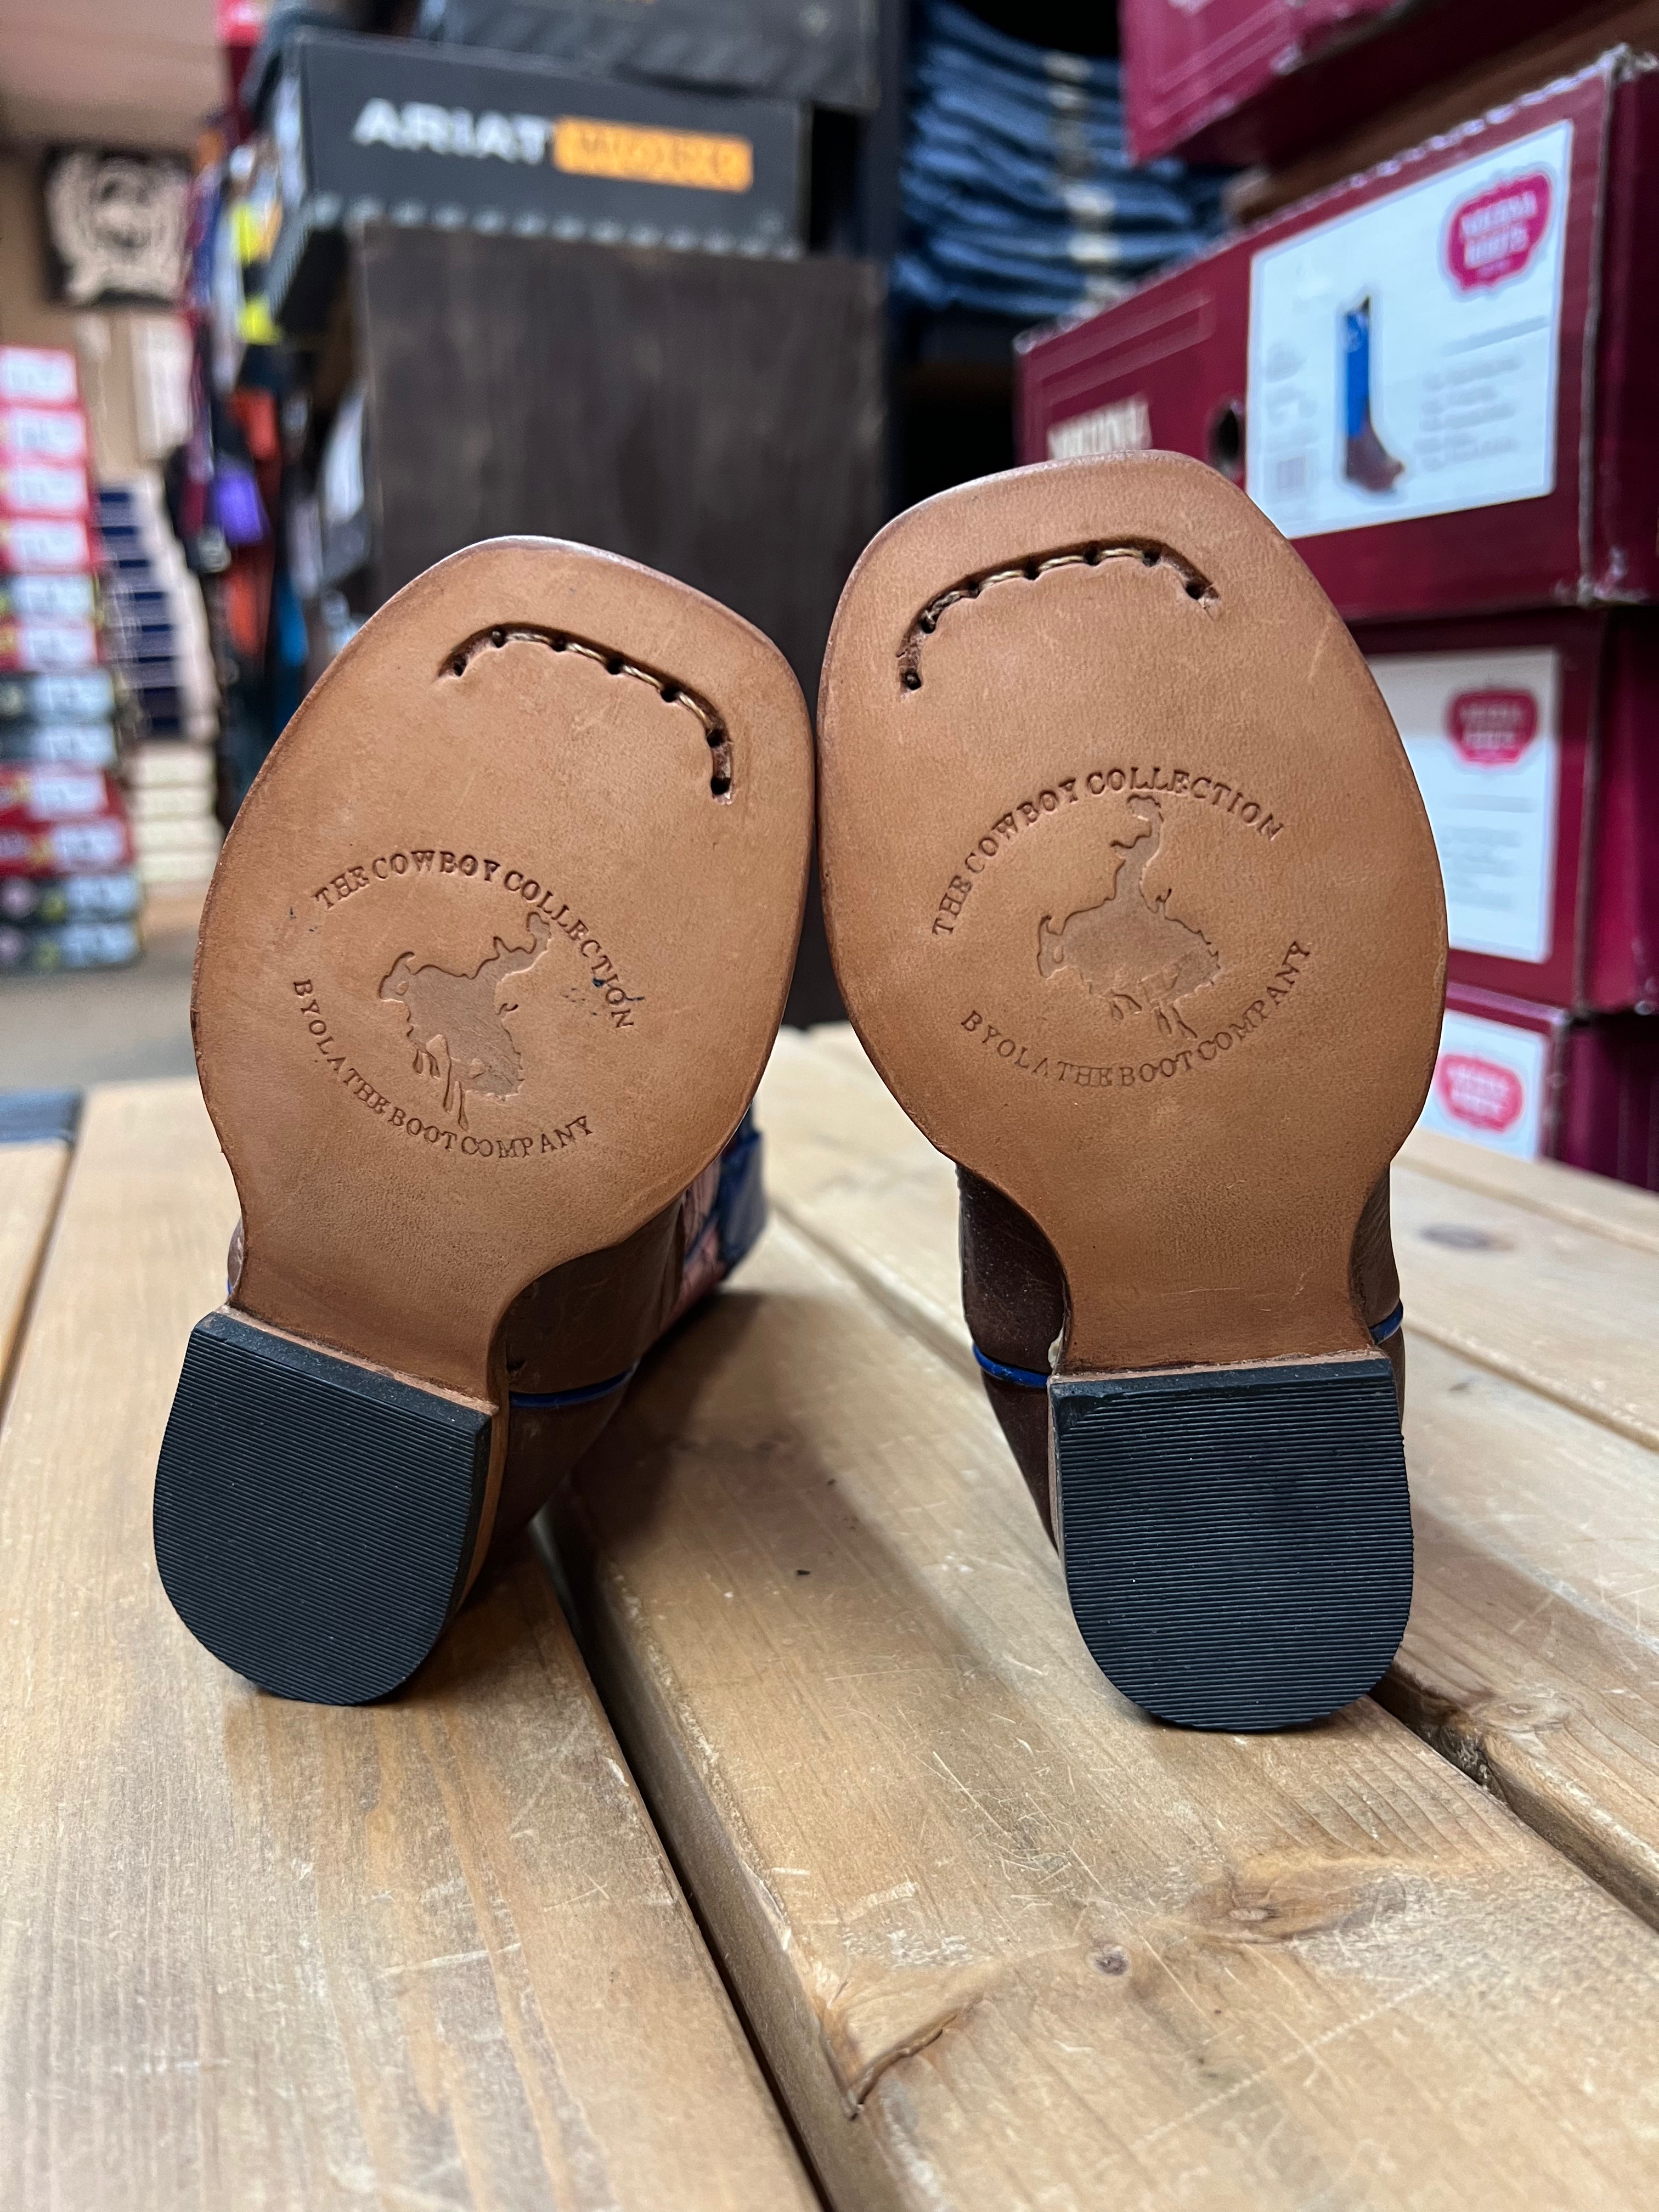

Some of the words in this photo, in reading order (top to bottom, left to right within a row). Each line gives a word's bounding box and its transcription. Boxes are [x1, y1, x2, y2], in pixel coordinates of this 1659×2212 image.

[353, 98, 550, 165] ARIAT
[932, 876, 973, 935] THE
[964, 777, 1078, 873] COWBOY
[1087, 767, 1284, 841] COLLECTION
[311, 866, 370, 909] THE
[372, 850, 500, 882] COWBOY
[504, 870, 635, 1029] COLLECTION
[961, 1010, 1001, 1043] BY
[1119, 1050, 1192, 1087] BOOT
[1197, 940, 1311, 1061] COMPANY
[293, 979, 321, 1014] BY
[387, 1107, 458, 1151] BOOT
[461, 1115, 594, 1159] COMPANY
